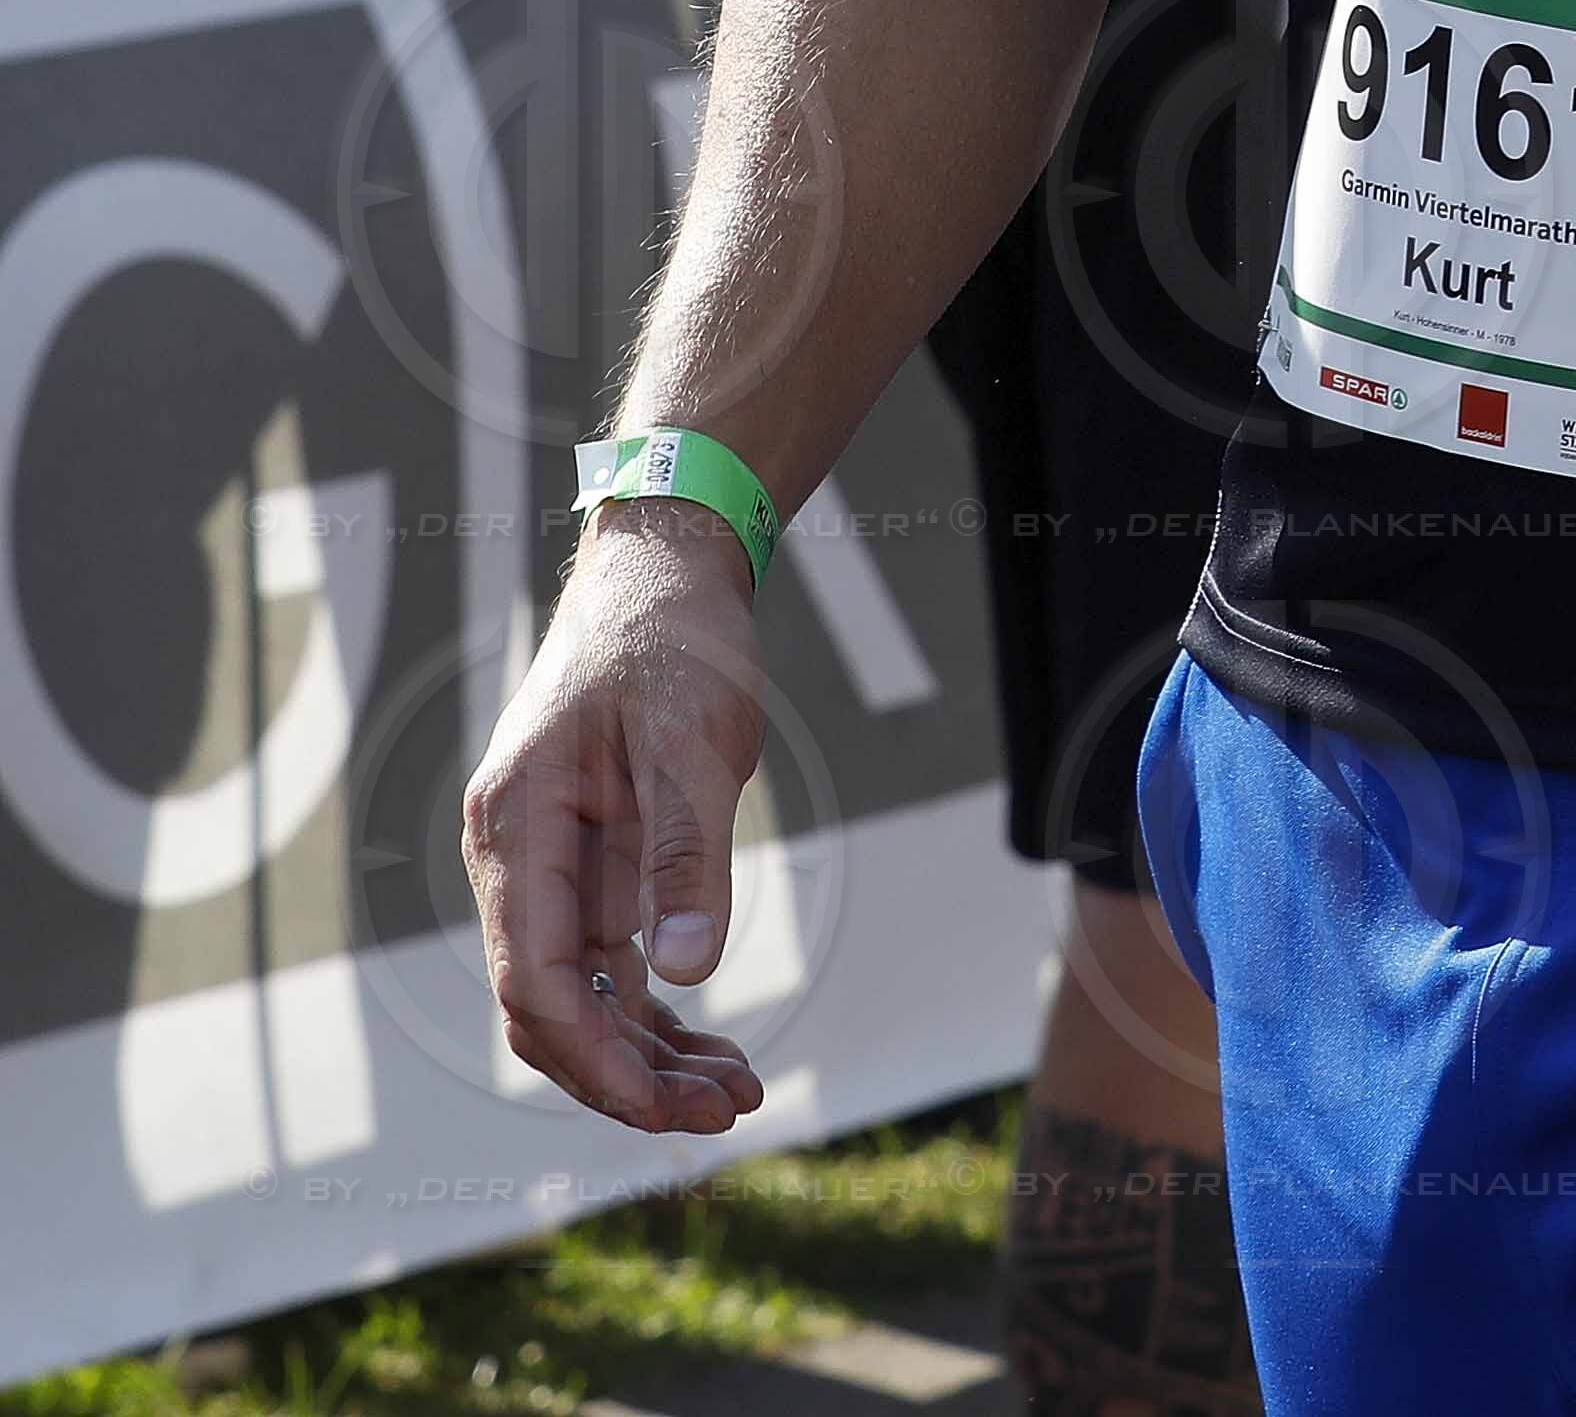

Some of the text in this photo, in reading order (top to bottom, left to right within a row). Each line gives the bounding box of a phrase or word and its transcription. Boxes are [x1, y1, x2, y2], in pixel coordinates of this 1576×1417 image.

[1341, 169, 1410, 210] Garmin
[1403, 236, 1516, 311] Kurt
[1332, 373, 1388, 404] SPAR
